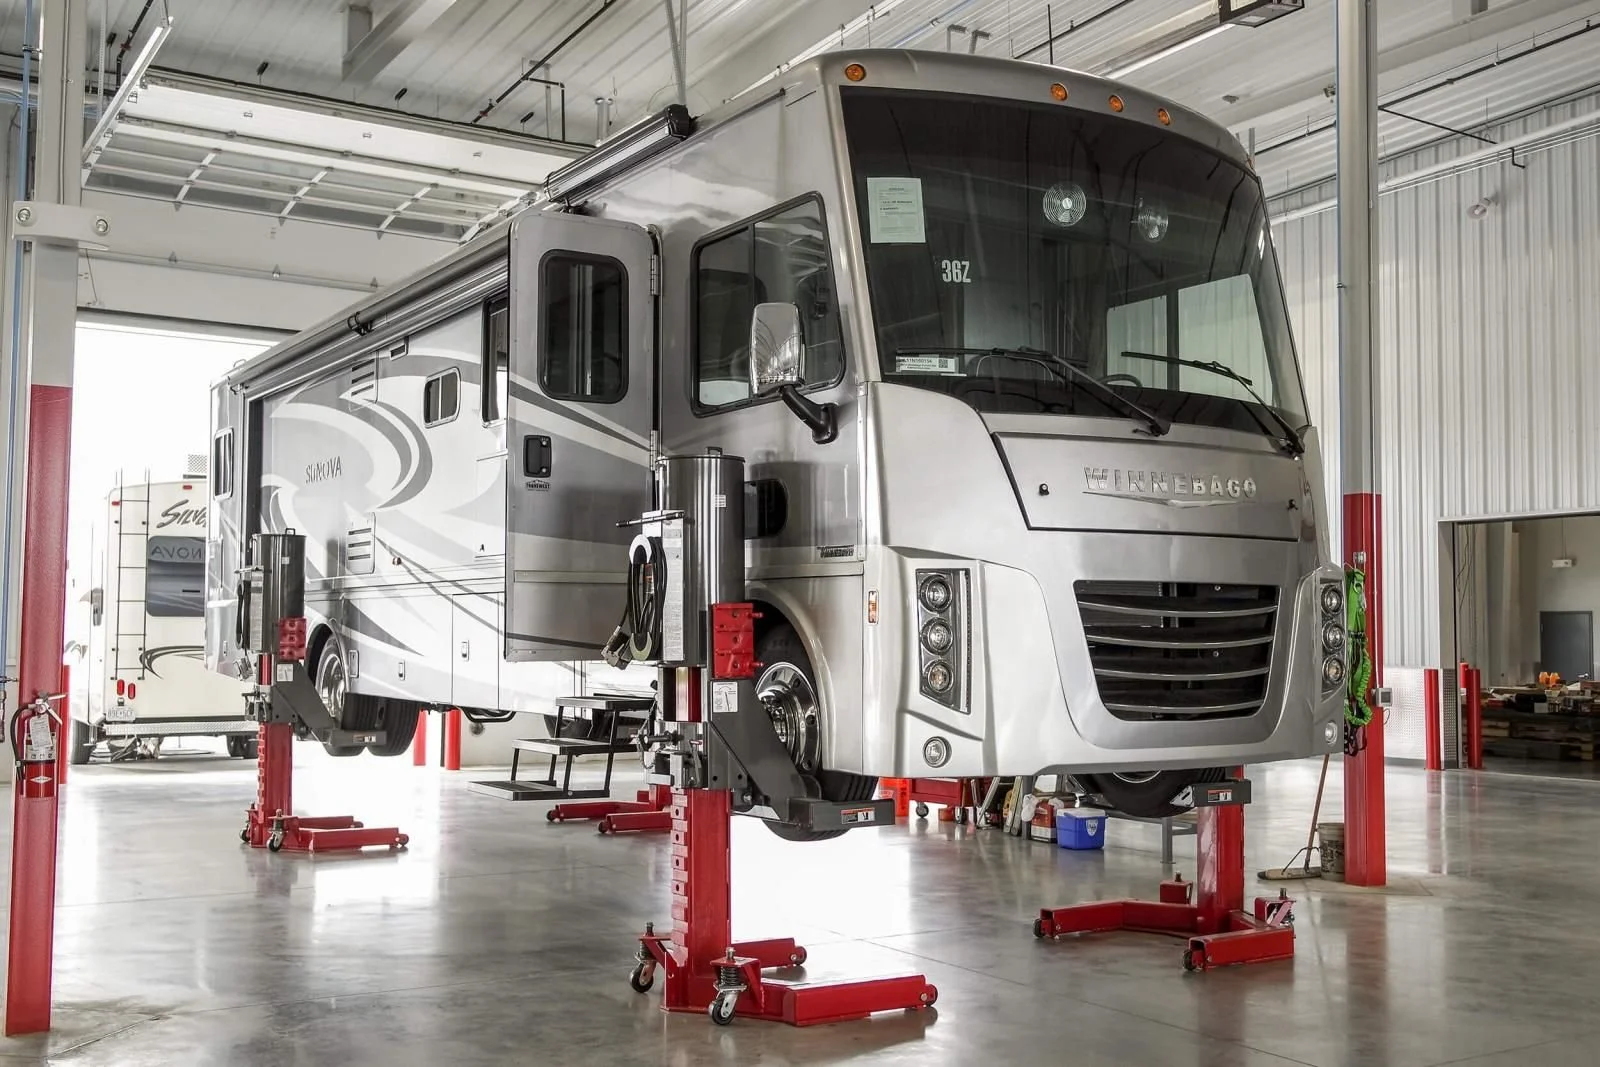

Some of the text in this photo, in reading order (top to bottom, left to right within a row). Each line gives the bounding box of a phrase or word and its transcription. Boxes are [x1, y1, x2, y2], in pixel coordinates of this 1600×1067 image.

[941, 259, 972, 283] 36Z
[1084, 466, 1257, 498] WINNEBAGO
[156, 499, 207, 528] SILVE
